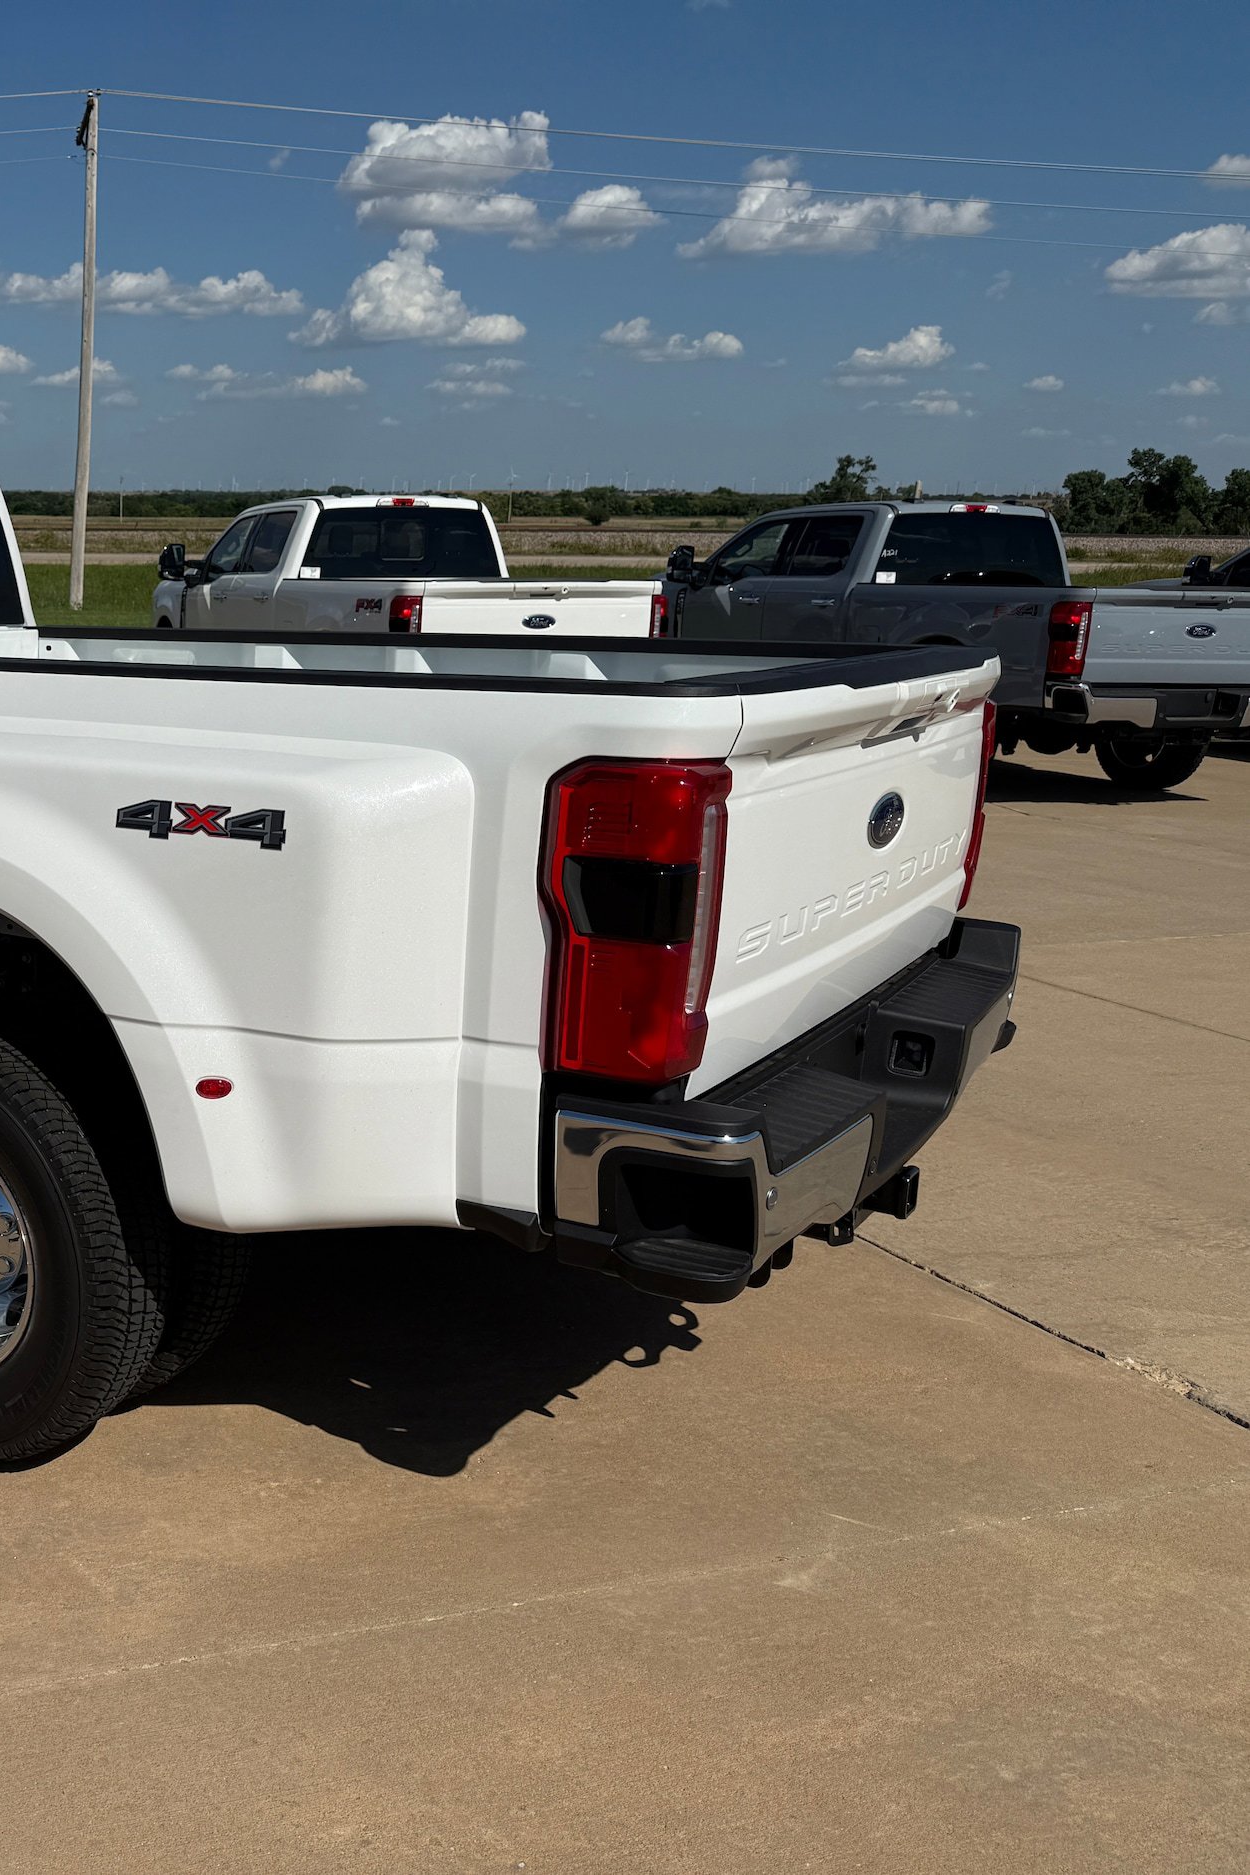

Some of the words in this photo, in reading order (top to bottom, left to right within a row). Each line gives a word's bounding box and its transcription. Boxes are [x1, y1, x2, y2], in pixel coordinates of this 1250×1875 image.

[355, 598, 382, 613] FX4
[1101, 643, 1206, 654] SUPER
[735, 870, 890, 964] SUPER
[896, 828, 967, 889] DUTY
